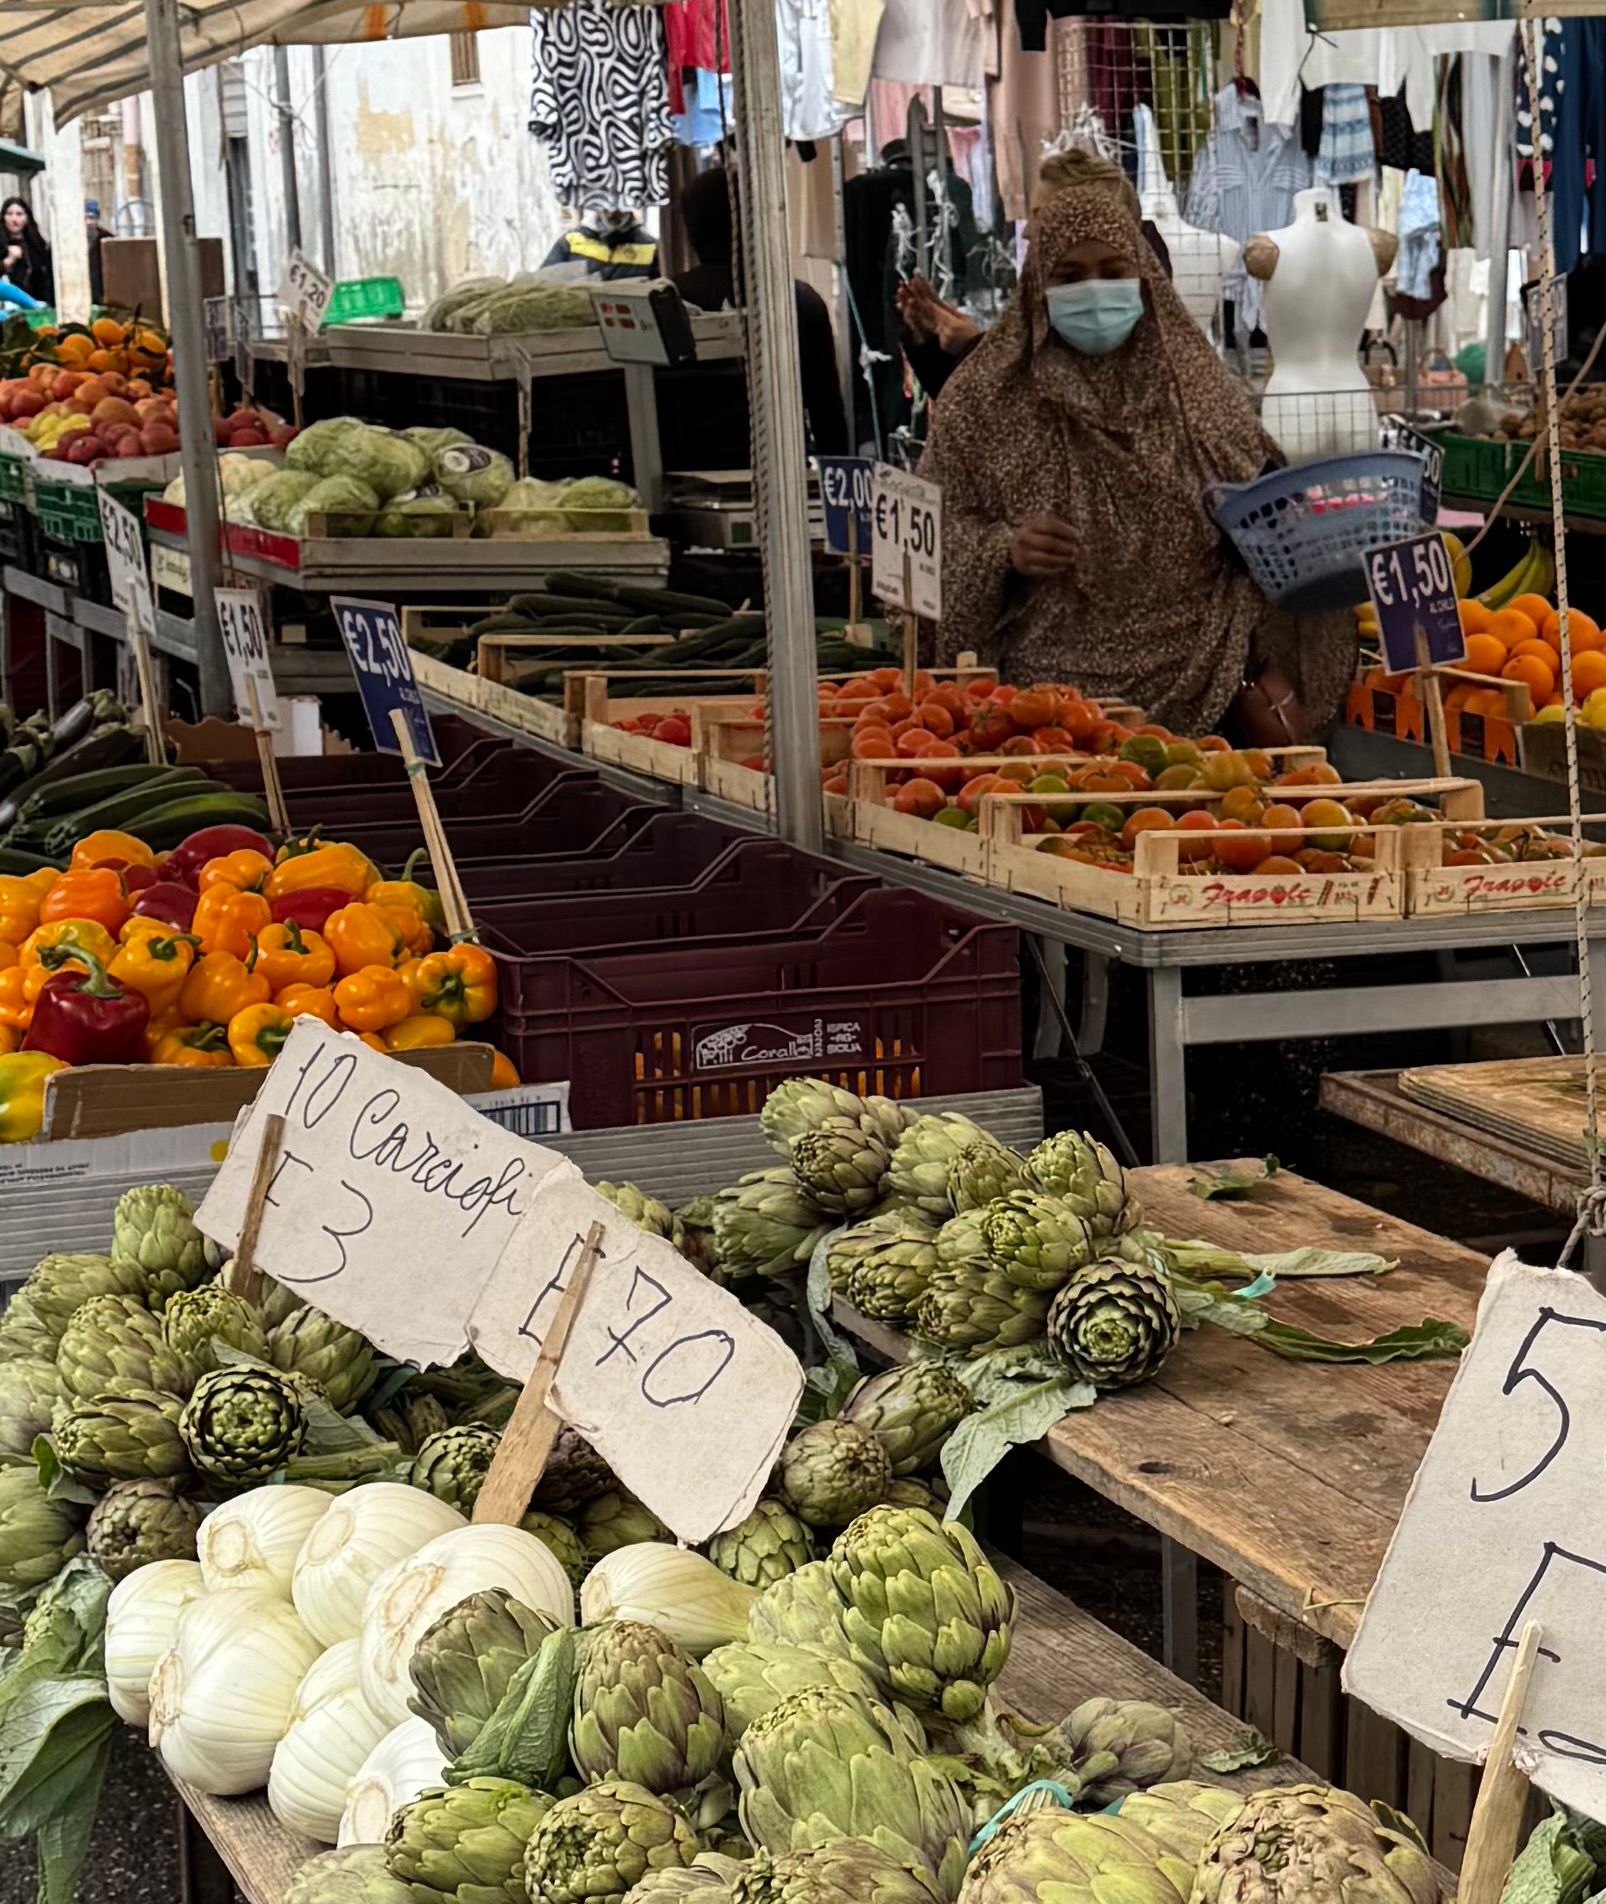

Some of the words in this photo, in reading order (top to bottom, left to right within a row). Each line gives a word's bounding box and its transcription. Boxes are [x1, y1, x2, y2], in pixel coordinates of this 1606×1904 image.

[876, 493, 935, 558] €1,50
[1372, 540, 1448, 608] €1,50
[219, 600, 264, 668] €1,50
[343, 610, 411, 688] €2,50
[285, 1042, 357, 1129] 10
